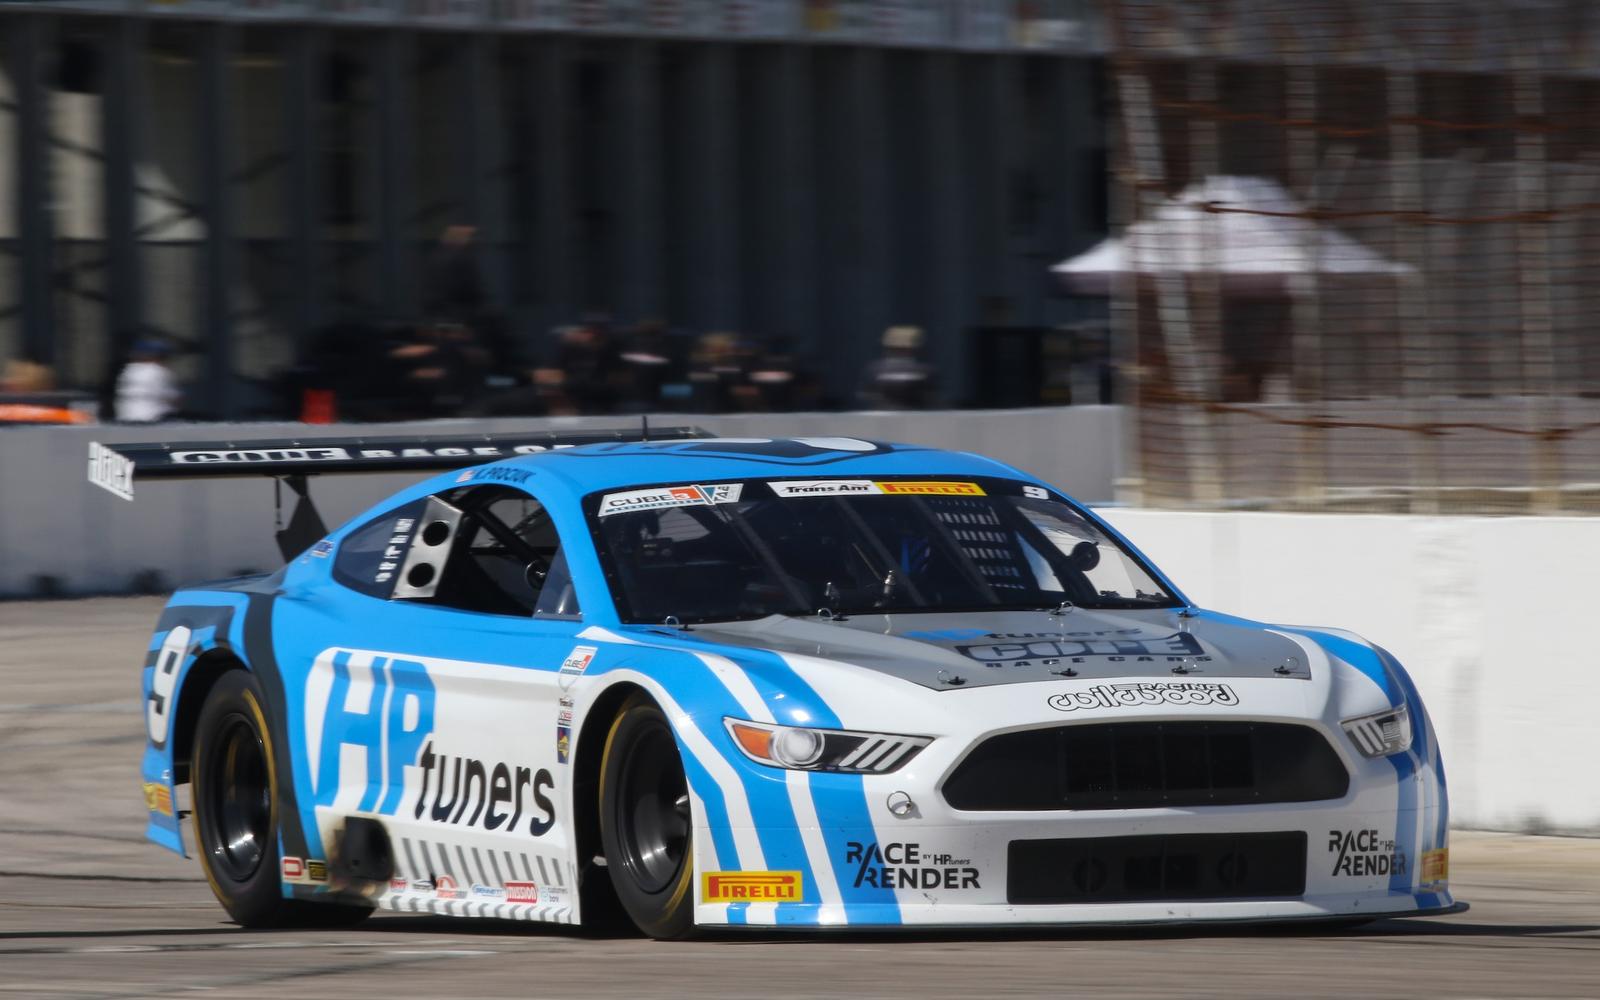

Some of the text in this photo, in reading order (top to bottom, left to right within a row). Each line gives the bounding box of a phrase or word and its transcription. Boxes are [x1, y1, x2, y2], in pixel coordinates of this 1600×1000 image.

[360, 449, 502, 459] RACE
[785, 484, 869, 494] Trans Am
[882, 483, 978, 494] PIRELLI
[1022, 485, 1049, 500] 9
[986, 657, 1086, 668] RACE
[147, 625, 192, 744] 9
[1141, 683, 1221, 691] RACING
[1328, 829, 1379, 852] RACE
[846, 841, 920, 866] RACE
[1331, 853, 1407, 876] RENDER
[708, 875, 796, 898] PIRELLI
[854, 867, 981, 890] RENDER
